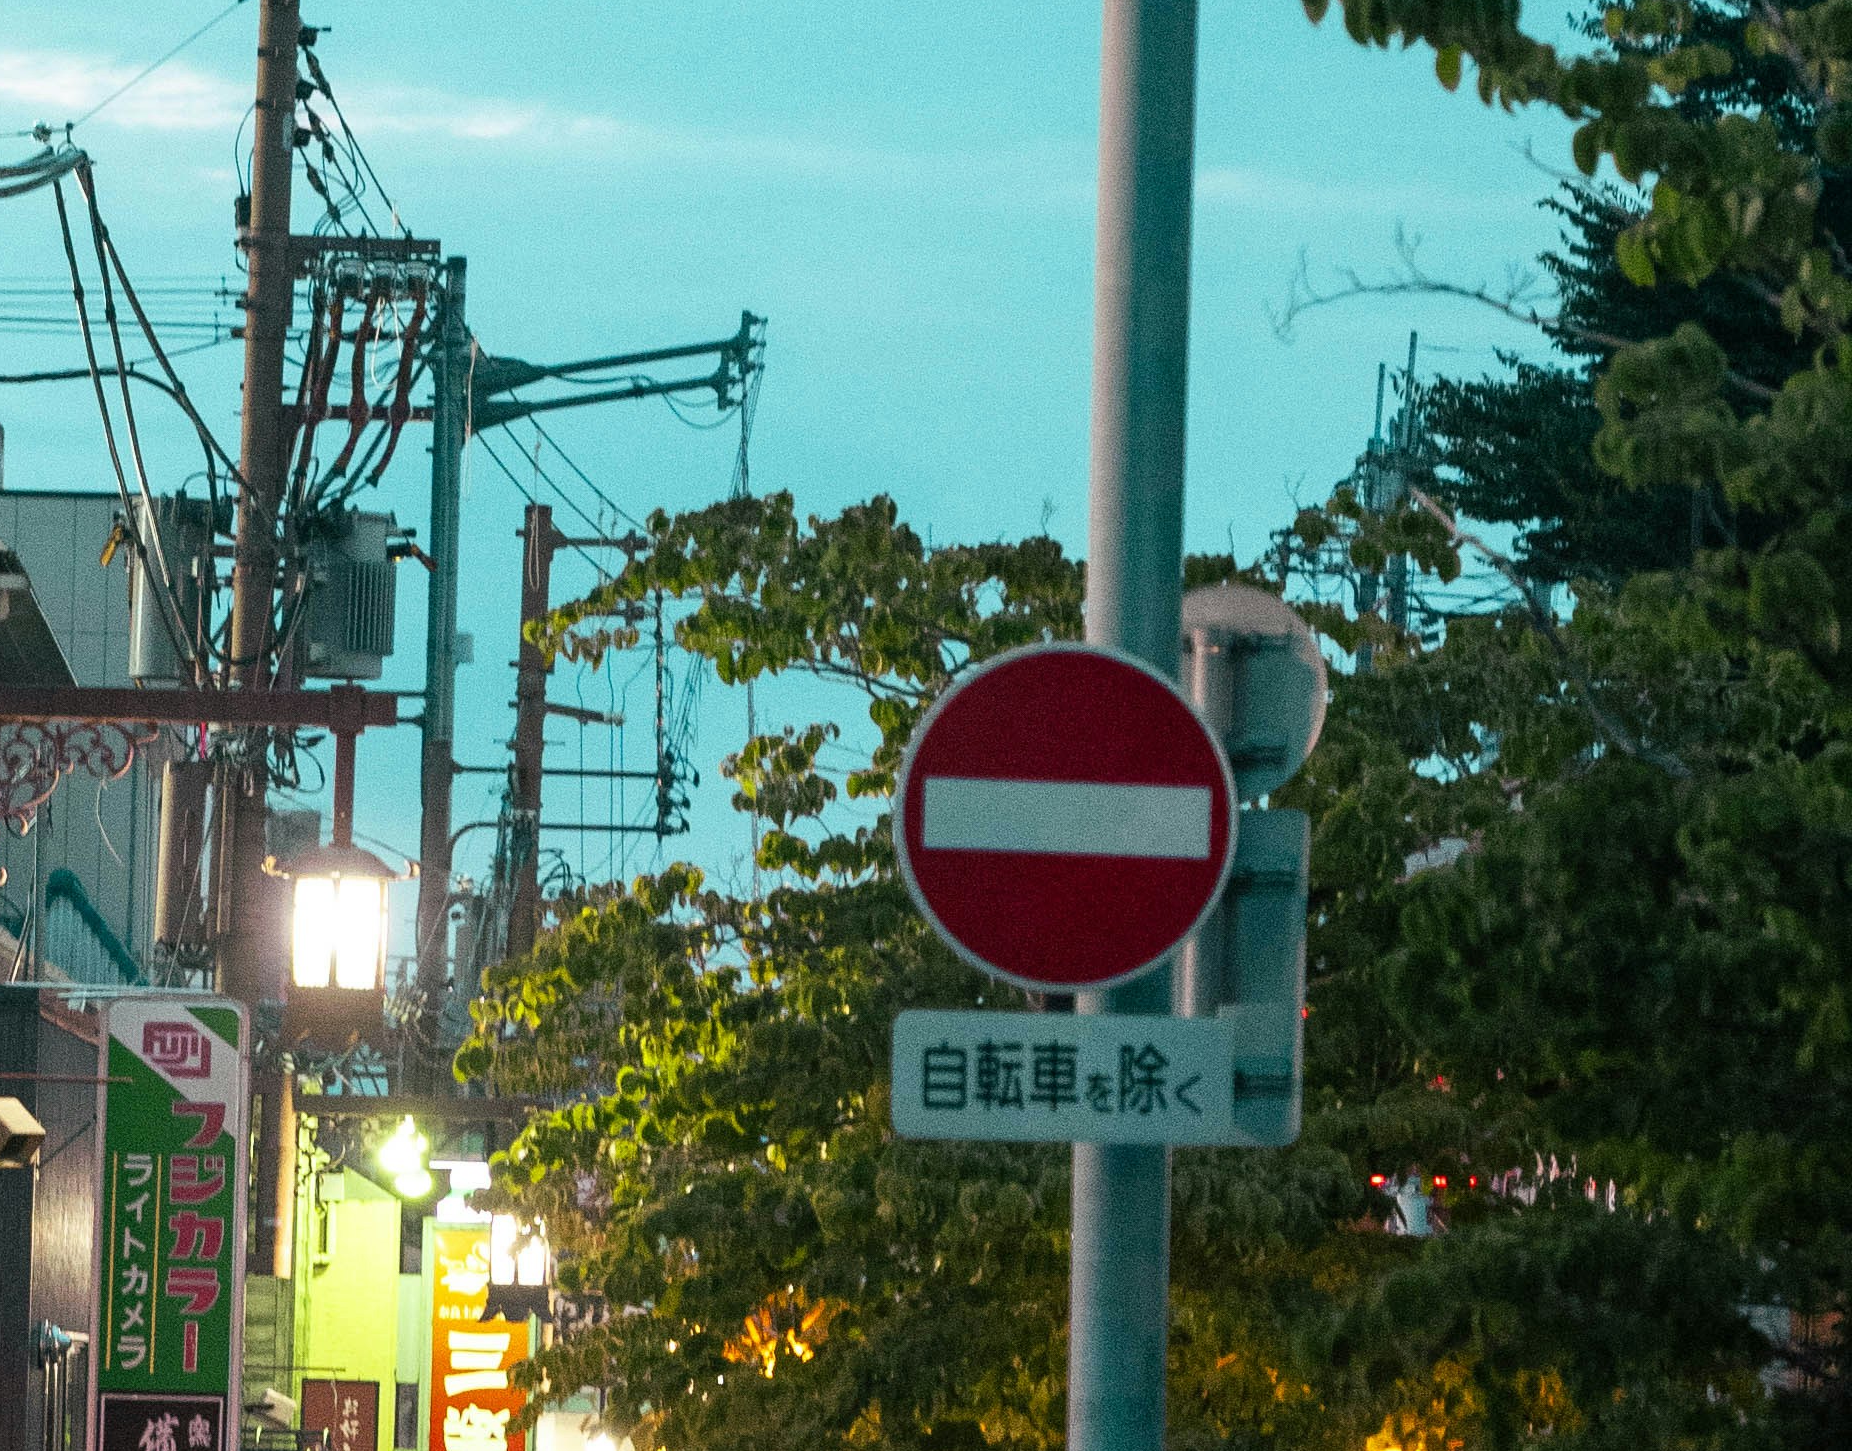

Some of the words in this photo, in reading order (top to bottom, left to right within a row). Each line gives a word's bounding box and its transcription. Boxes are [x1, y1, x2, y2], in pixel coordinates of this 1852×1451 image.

[923, 1040, 1204, 1115] 自転車を除く
[117, 1154, 153, 1370] ライトカメラ
[166, 1101, 226, 1373] フジカラー
